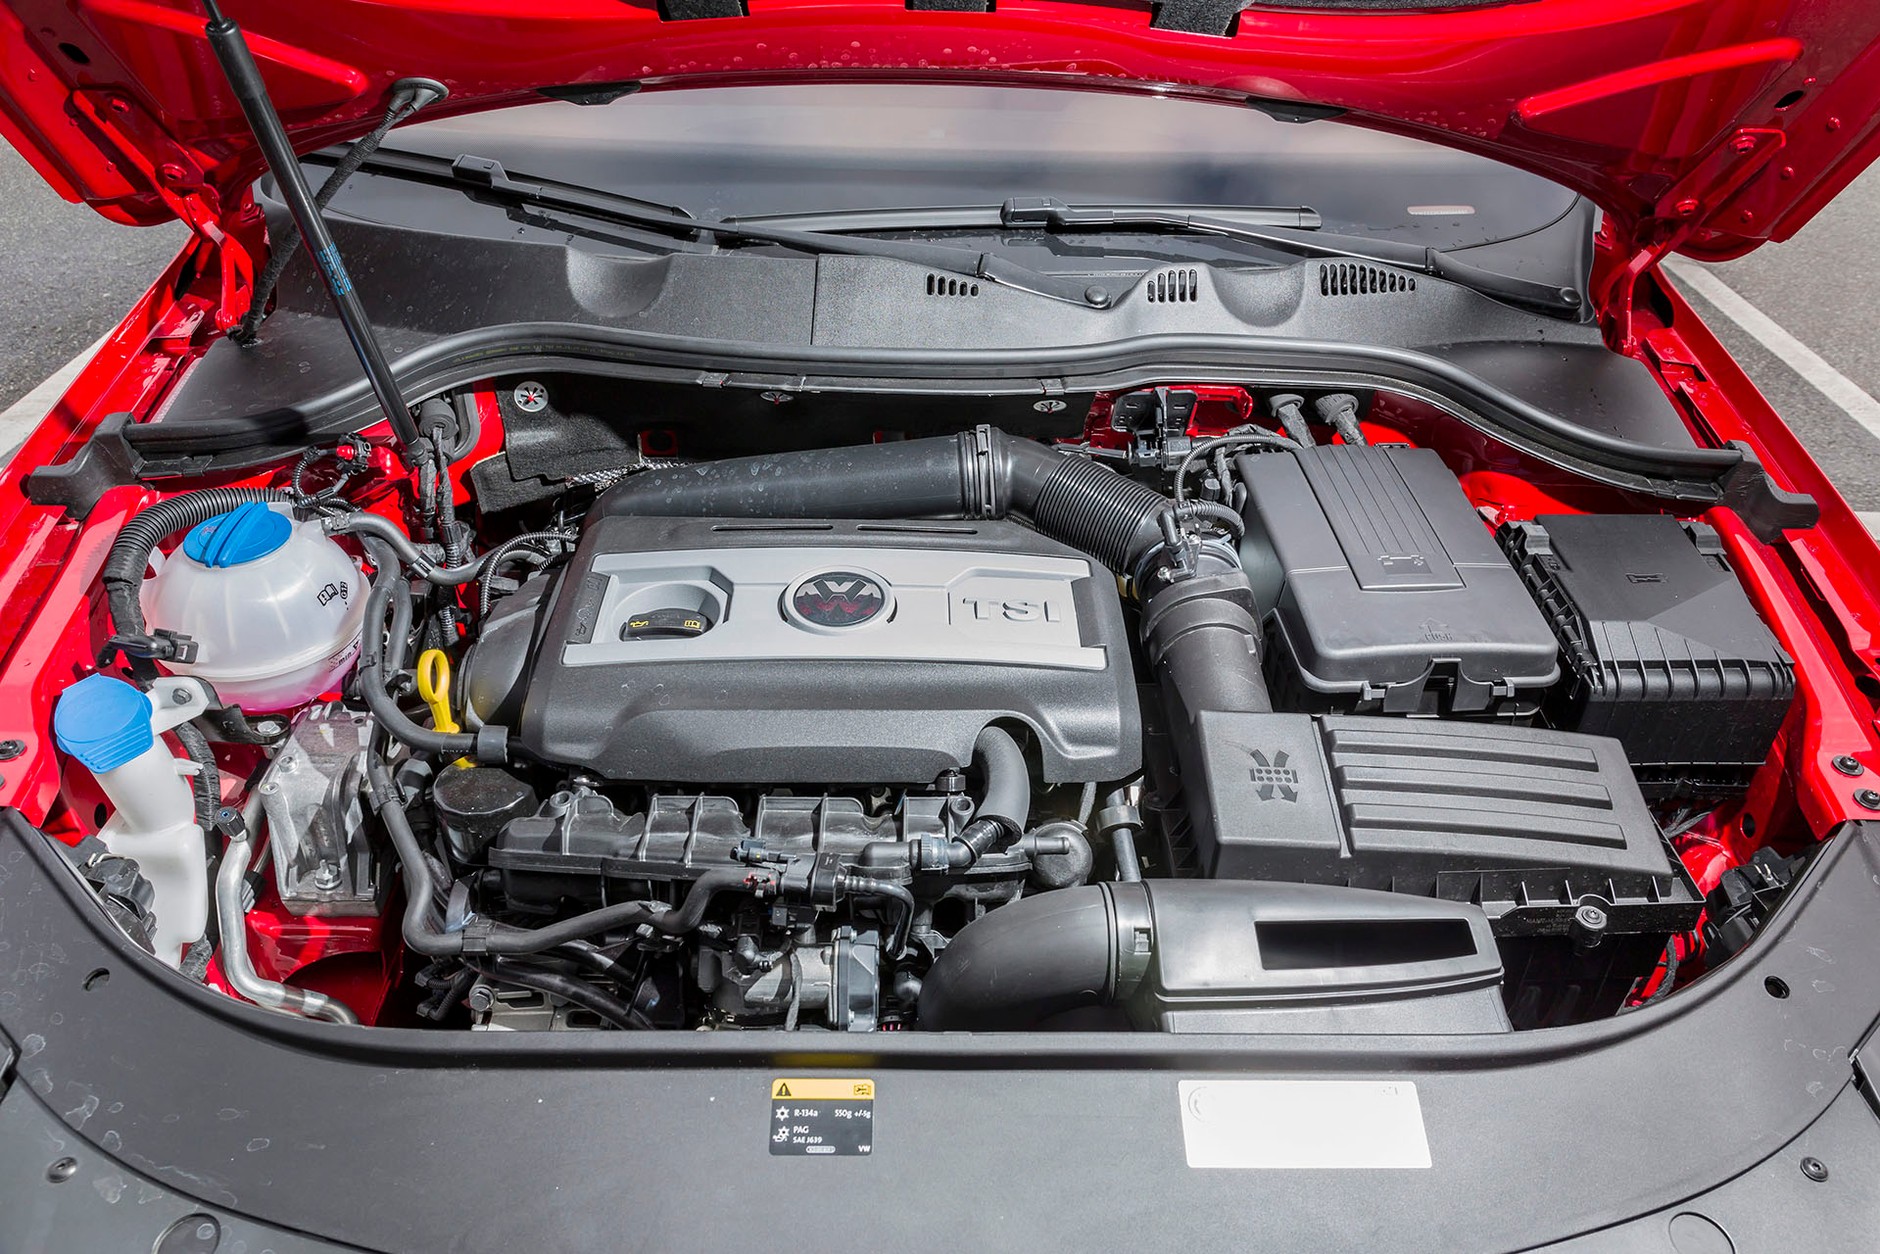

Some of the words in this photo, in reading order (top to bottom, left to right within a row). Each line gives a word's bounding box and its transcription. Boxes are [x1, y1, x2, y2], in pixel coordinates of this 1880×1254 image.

[963, 598, 1060, 622] TSI
[793, 1108, 819, 1117] R-134a
[834, 1108, 853, 1119] 550g
[793, 1125, 810, 1134] PAG
[793, 1136, 805, 1144] SAE
[806, 1136, 823, 1144] J639
